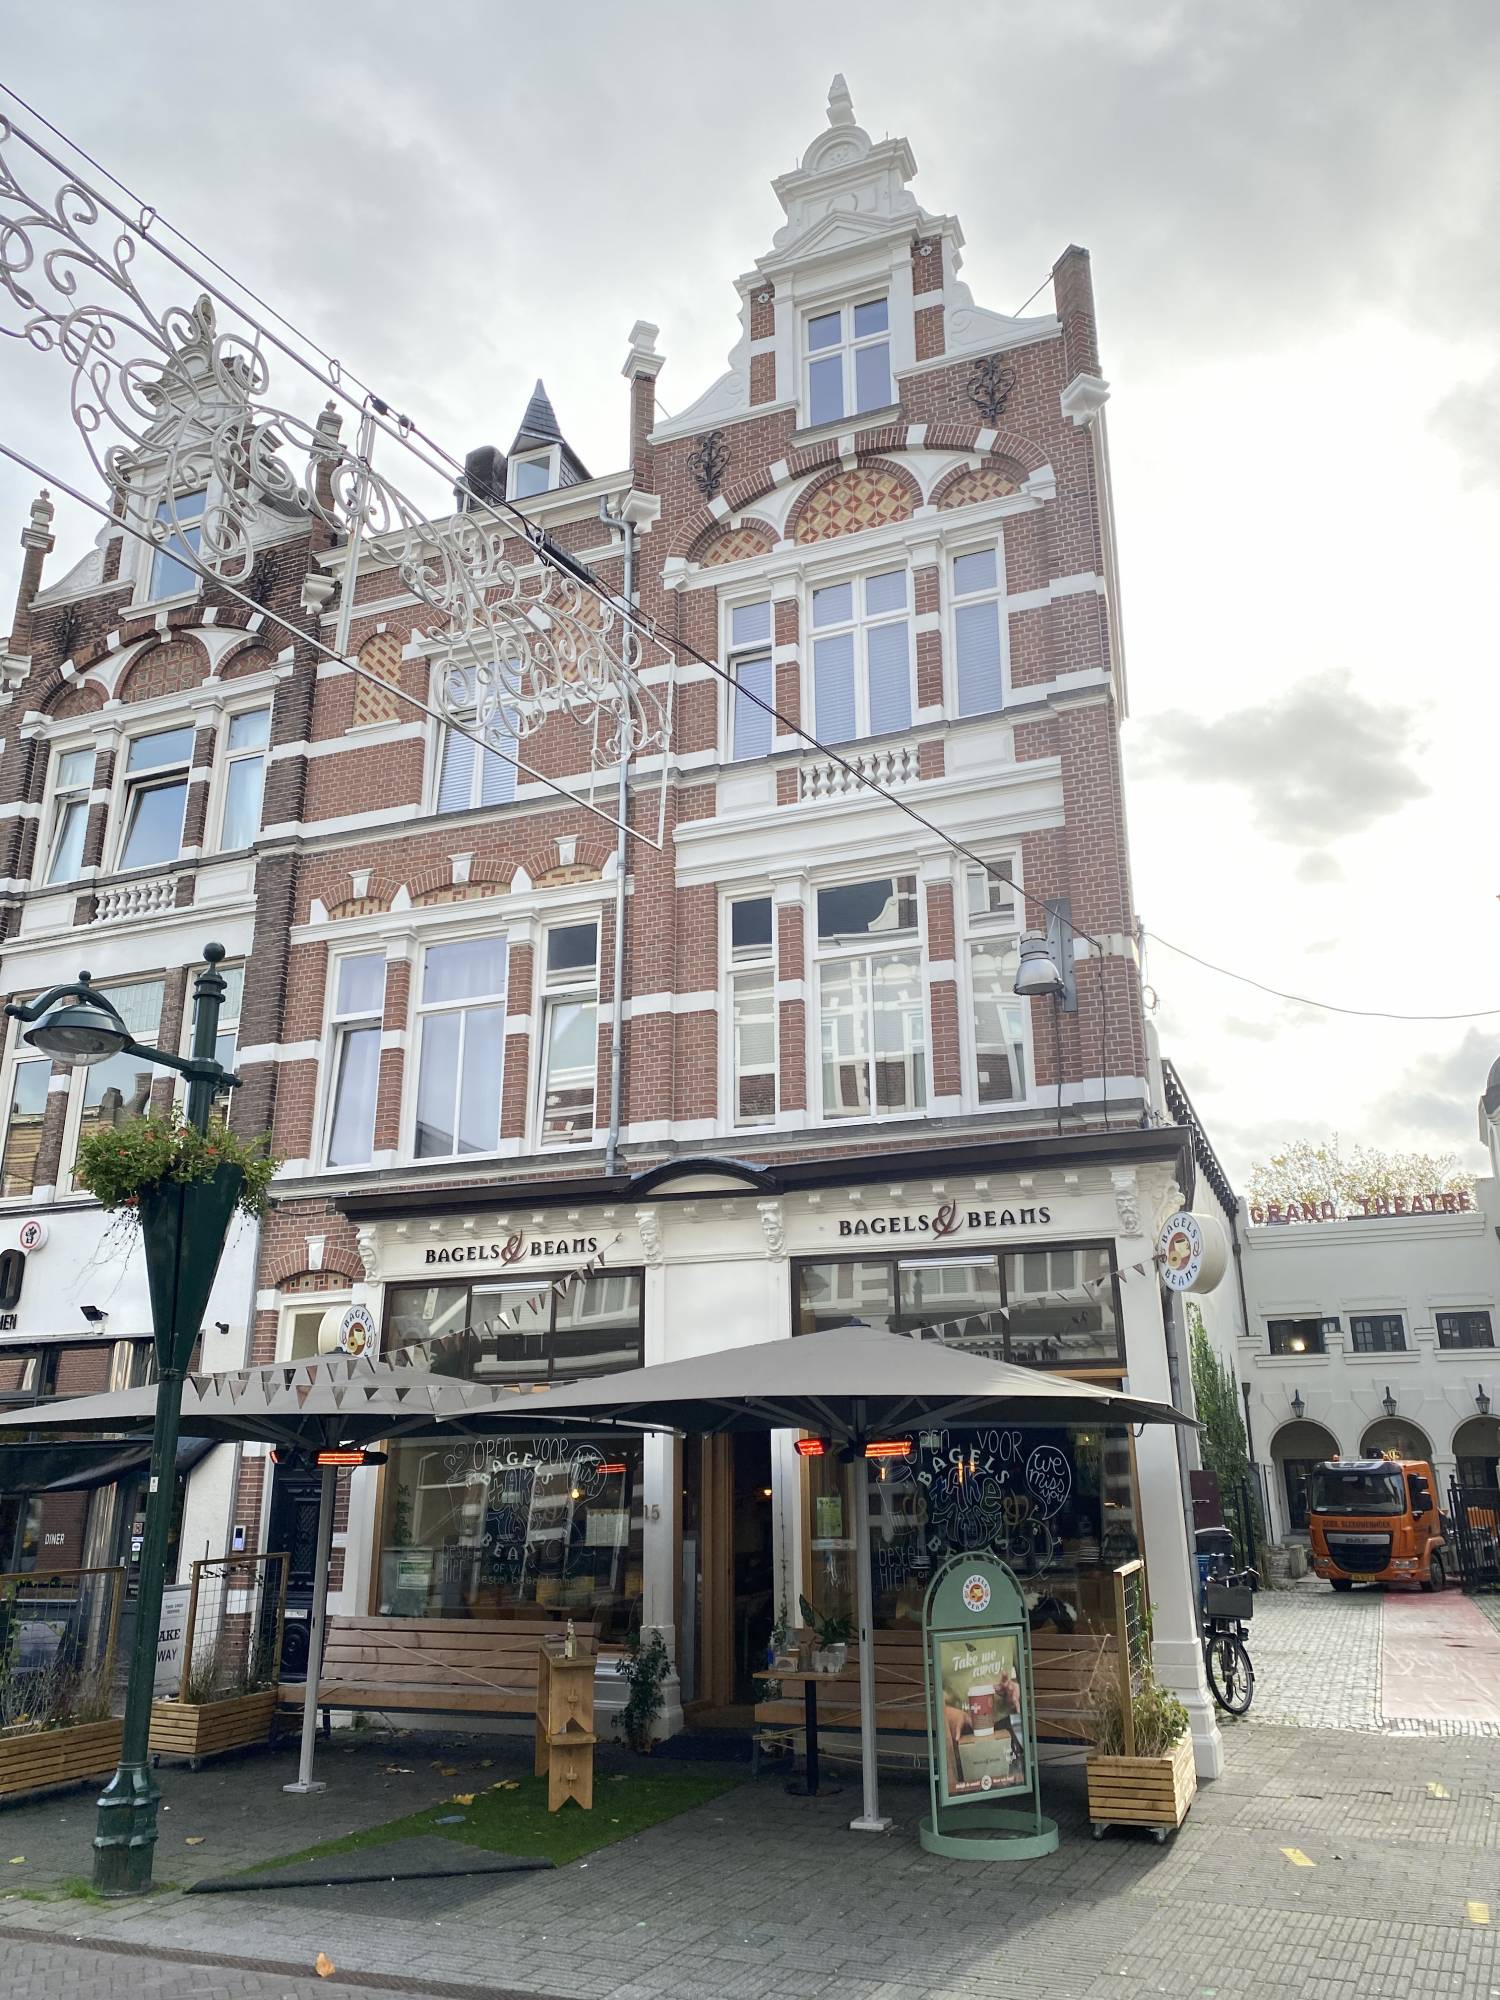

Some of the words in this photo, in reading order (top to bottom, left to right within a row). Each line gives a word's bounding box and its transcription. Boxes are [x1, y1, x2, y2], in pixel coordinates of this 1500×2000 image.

[1251, 1201, 1336, 1223] GRAND
[1357, 1191, 1471, 1216] THEATRE
[838, 1214, 930, 1236] BAGELS
[931, 1199, 964, 1240] &
[967, 1206, 1051, 1228] BEANS
[1161, 1217, 1198, 1244] BAGELS
[425, 1244, 500, 1264] BAGELS
[501, 1229, 529, 1267] &
[530, 1237, 598, 1256] BEANS
[1165, 1262, 1198, 1286] BEANS
[344, 1309, 372, 1333] BAGELS
[531, 1437, 569, 1467] VOOR
[976, 1429, 1024, 1463] VOOR
[481, 1451, 554, 1486] BAGELS
[917, 1447, 1010, 1488] BAGELS
[1034, 1453, 1066, 1476] we
[1029, 1468, 1066, 1493] miss
[1039, 1486, 1066, 1504] you
[643, 1504, 660, 1520] 15
[44, 1533, 65, 1545] DINER
[158, 1629, 181, 1642] AKE
[157, 1648, 178, 1662] WAY
[952, 1652, 978, 1672] Take
